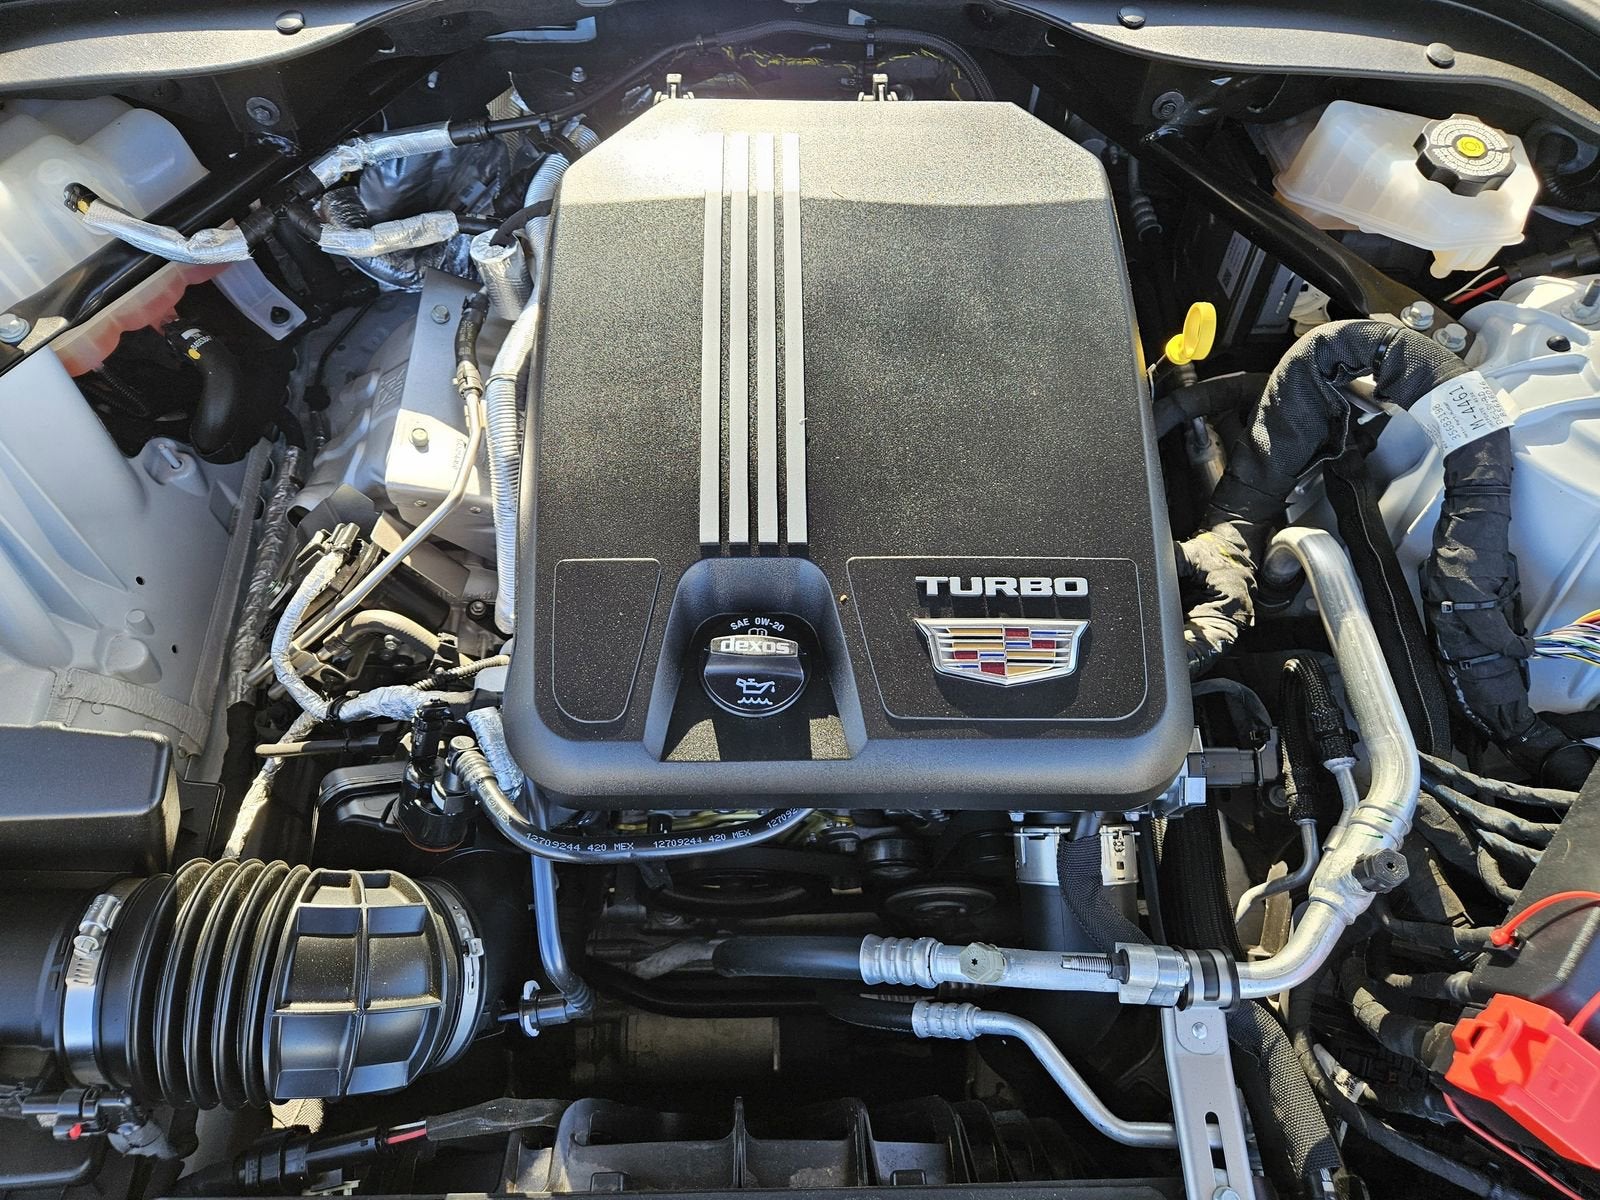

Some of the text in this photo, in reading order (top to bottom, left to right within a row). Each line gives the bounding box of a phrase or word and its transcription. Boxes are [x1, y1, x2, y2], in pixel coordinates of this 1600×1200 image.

[1448, 385, 1486, 430] M-4461
[915, 576, 1089, 597] TURBO
[730, 617, 785, 632] SAE 0W-20
[720, 637, 790, 655] dexos
[525, 832, 580, 852] 12709244
[587, 843, 607, 852] 420
[613, 841, 634, 851] MEX
[652, 836, 702, 849] 12709244
[708, 833, 726, 842] 420
[732, 828, 752, 839] MEX
